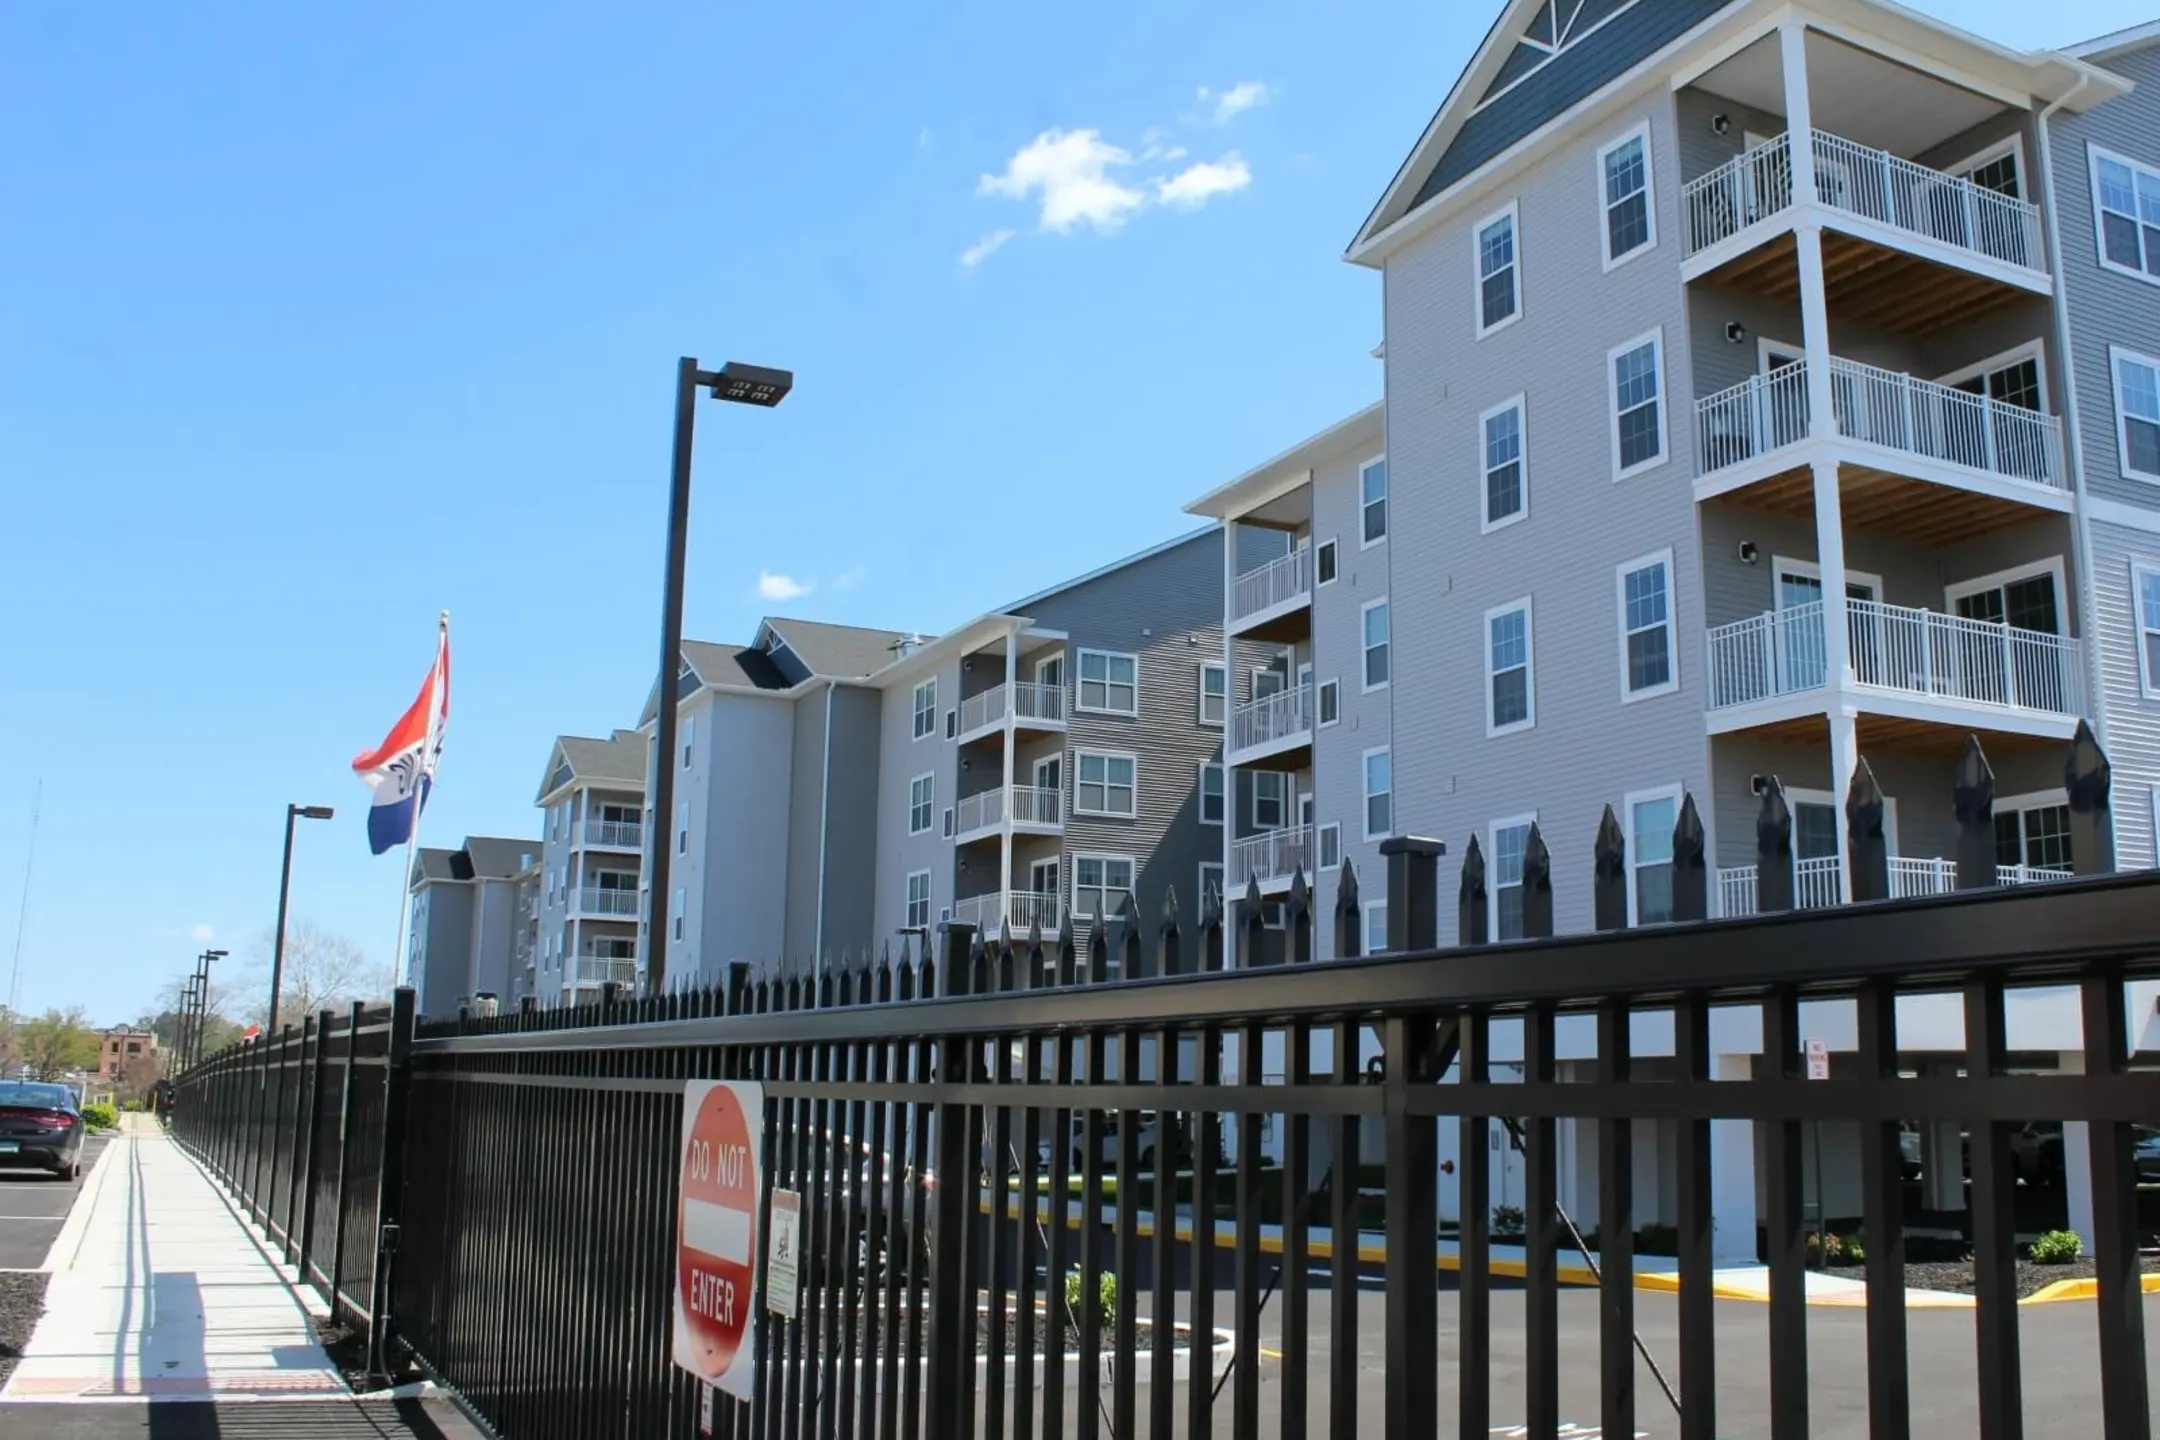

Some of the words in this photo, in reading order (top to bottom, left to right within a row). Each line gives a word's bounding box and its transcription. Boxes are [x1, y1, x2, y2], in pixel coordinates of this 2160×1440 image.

[692, 1139, 710, 1182] DO
[717, 1143, 746, 1188] NOT
[690, 1268, 734, 1327] ENTER
